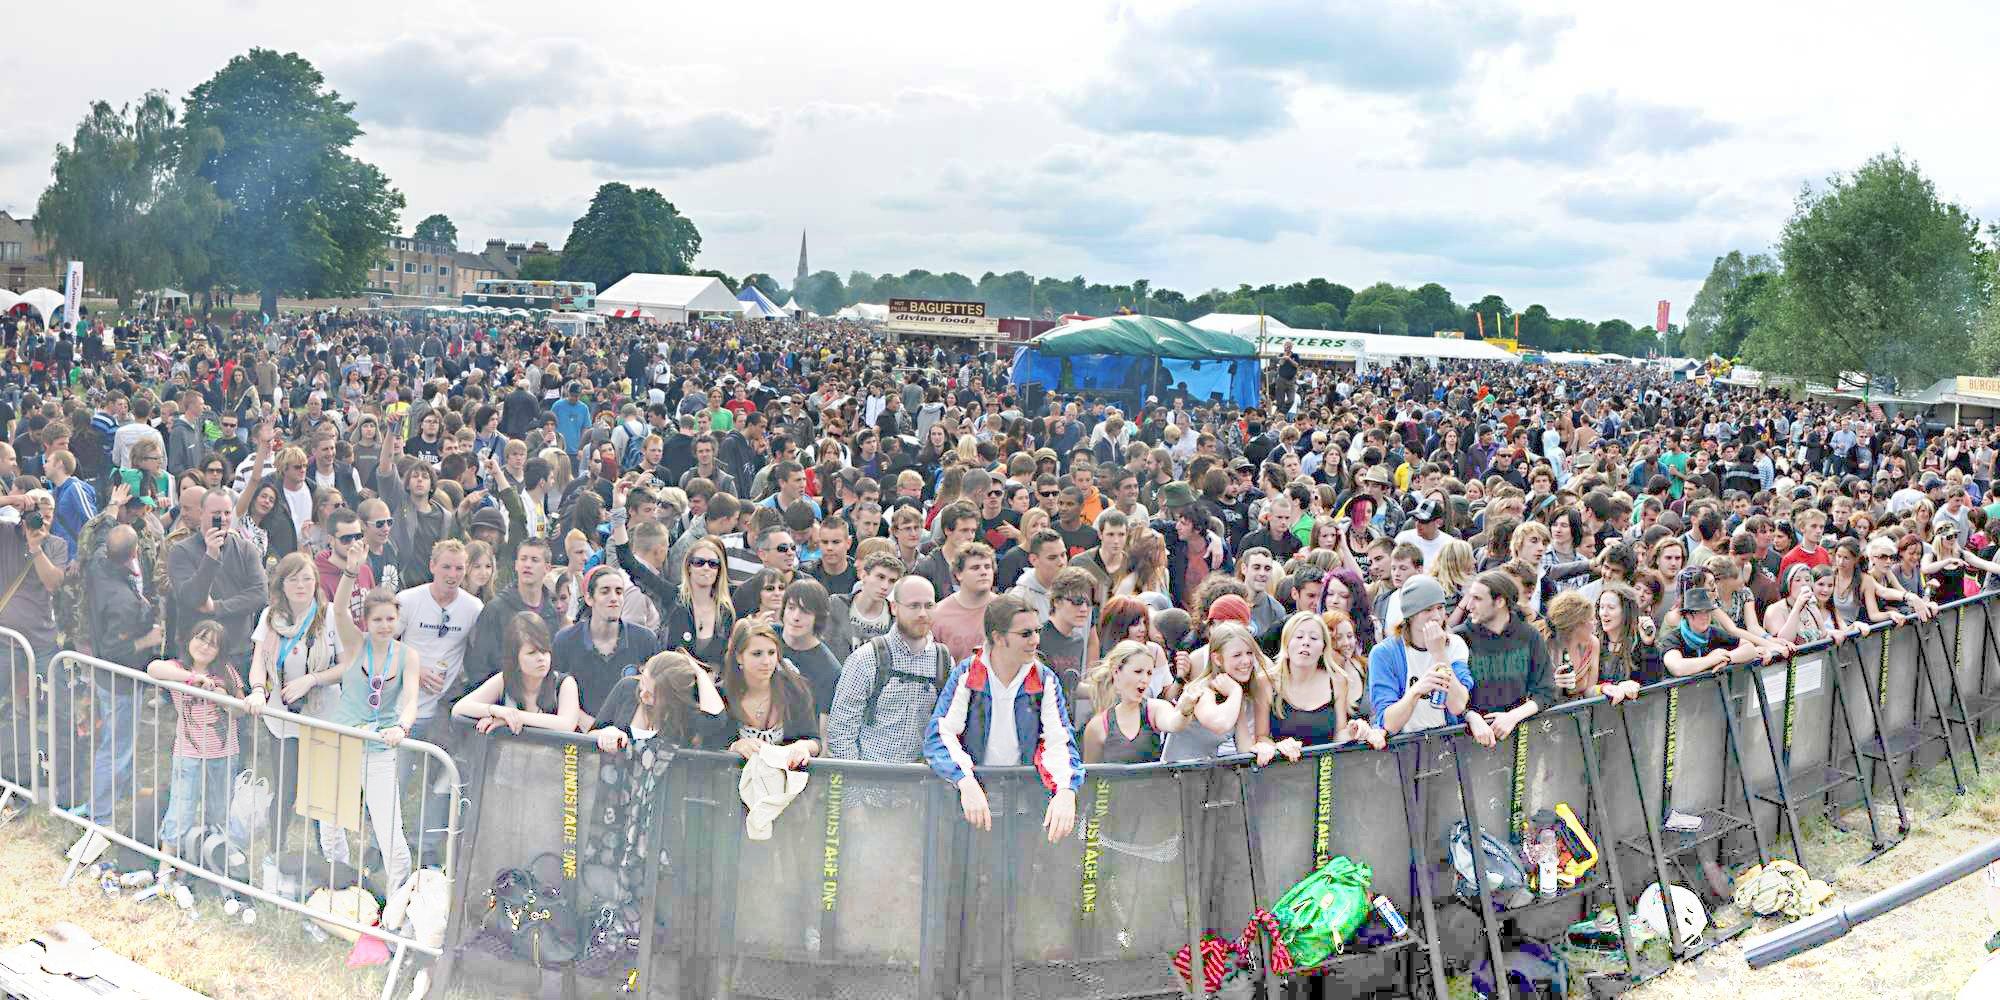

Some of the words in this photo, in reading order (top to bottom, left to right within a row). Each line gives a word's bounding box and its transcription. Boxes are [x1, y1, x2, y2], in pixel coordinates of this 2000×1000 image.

[896, 313, 936, 322] divine
[939, 315, 976, 324] foods
[909, 301, 983, 316] BAGUETTES
[1254, 336, 1346, 348] SIZZLERS
[563, 744, 577, 844] SOUNDSTAGE
[823, 773, 843, 877] SOUNDSTAGE
[1317, 755, 1333, 856] SOUNDSTAGE
[1085, 779, 1110, 880] SOUNDSTAGE
[563, 848, 577, 880] ONE
